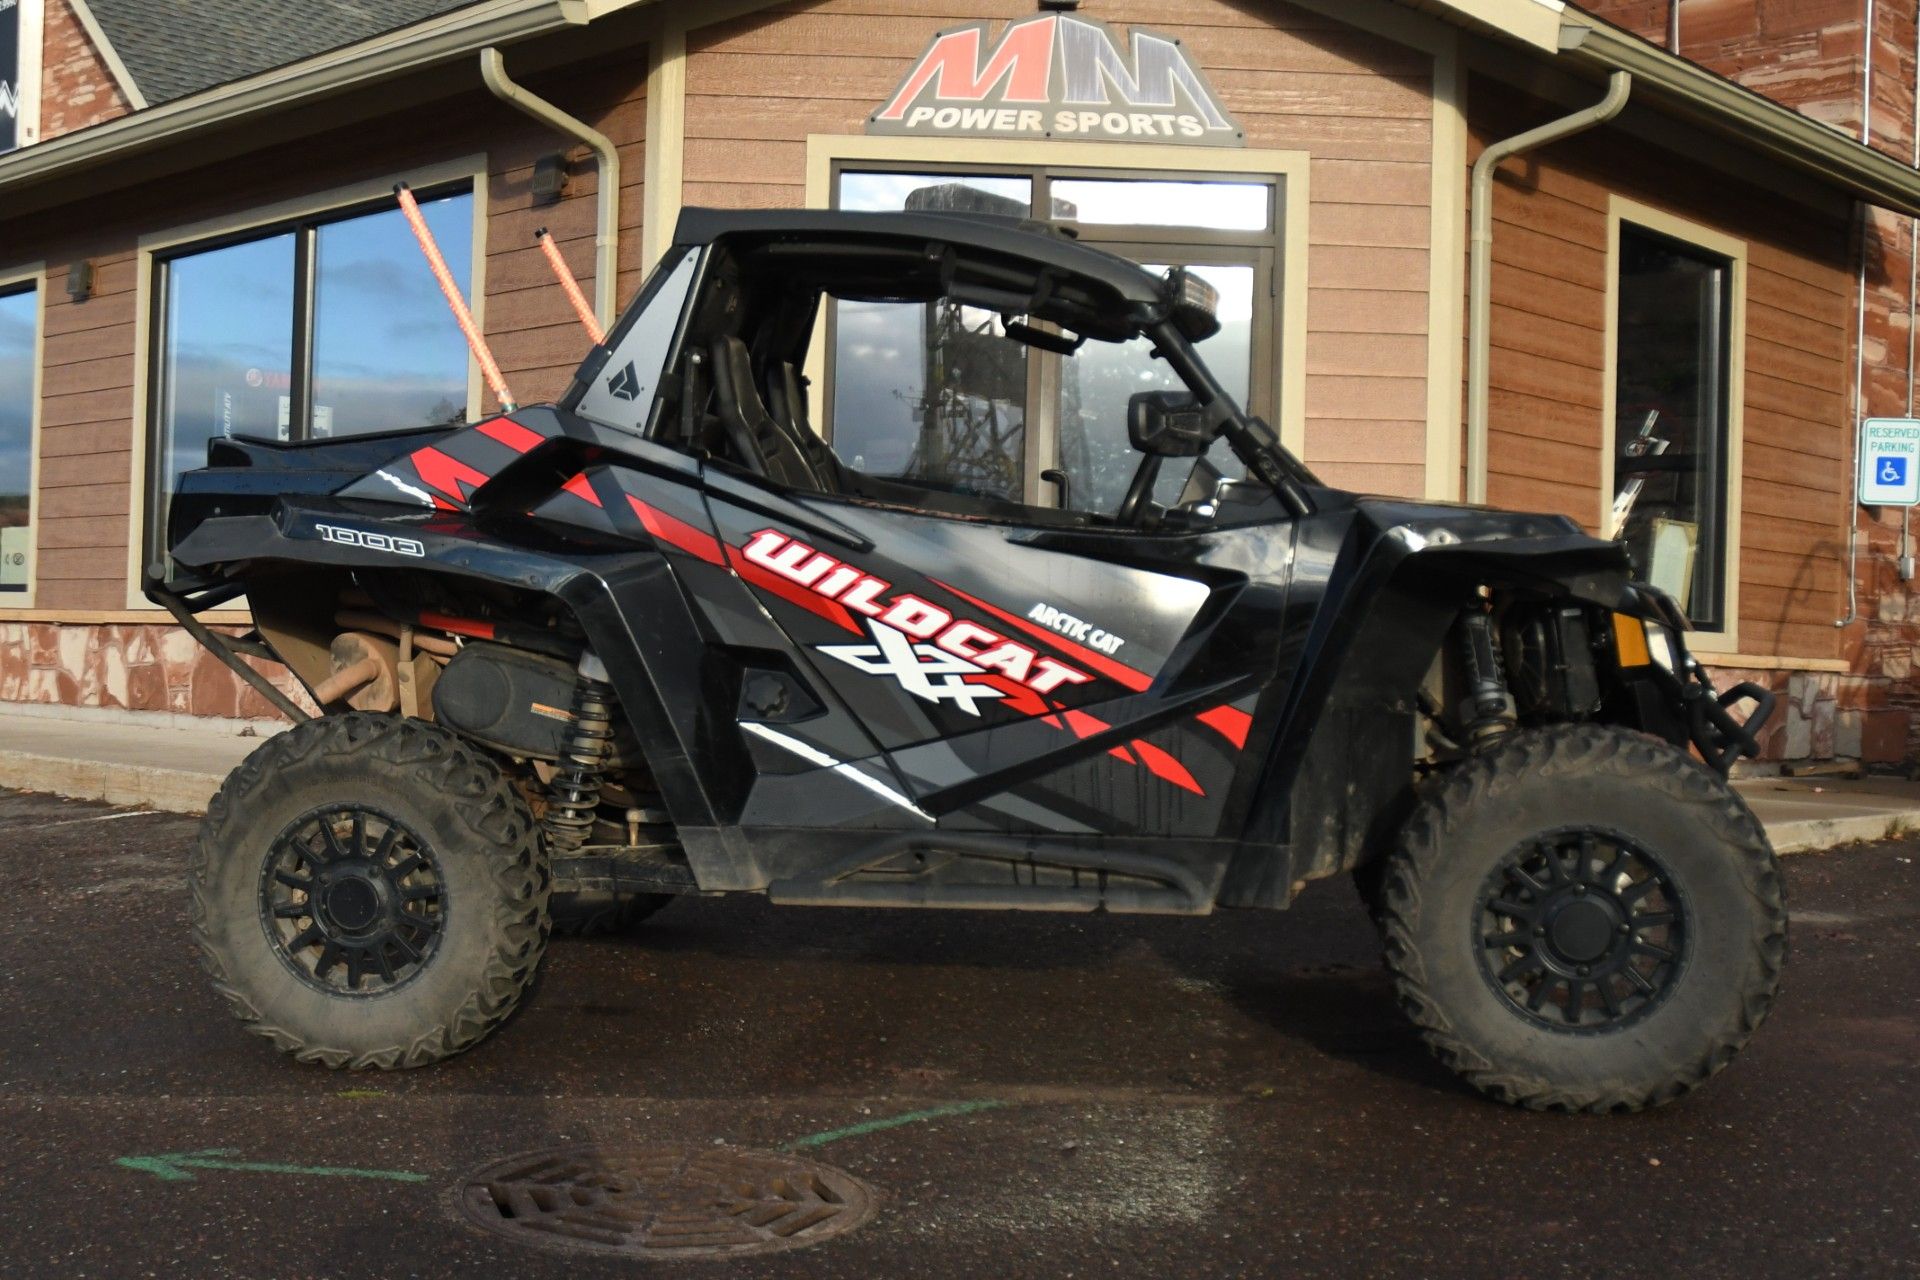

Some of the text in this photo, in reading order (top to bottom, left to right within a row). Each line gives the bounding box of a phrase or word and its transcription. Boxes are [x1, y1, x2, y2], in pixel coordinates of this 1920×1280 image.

[906, 107, 1204, 136] POWER SPORTS
[1869, 427, 1920, 439] RESERVED
[1871, 442, 1915, 453] PARKING
[315, 523, 425, 557] 1000
[742, 529, 1096, 693] WILDCAT
[1028, 602, 1125, 654] ARCTIC CAT
